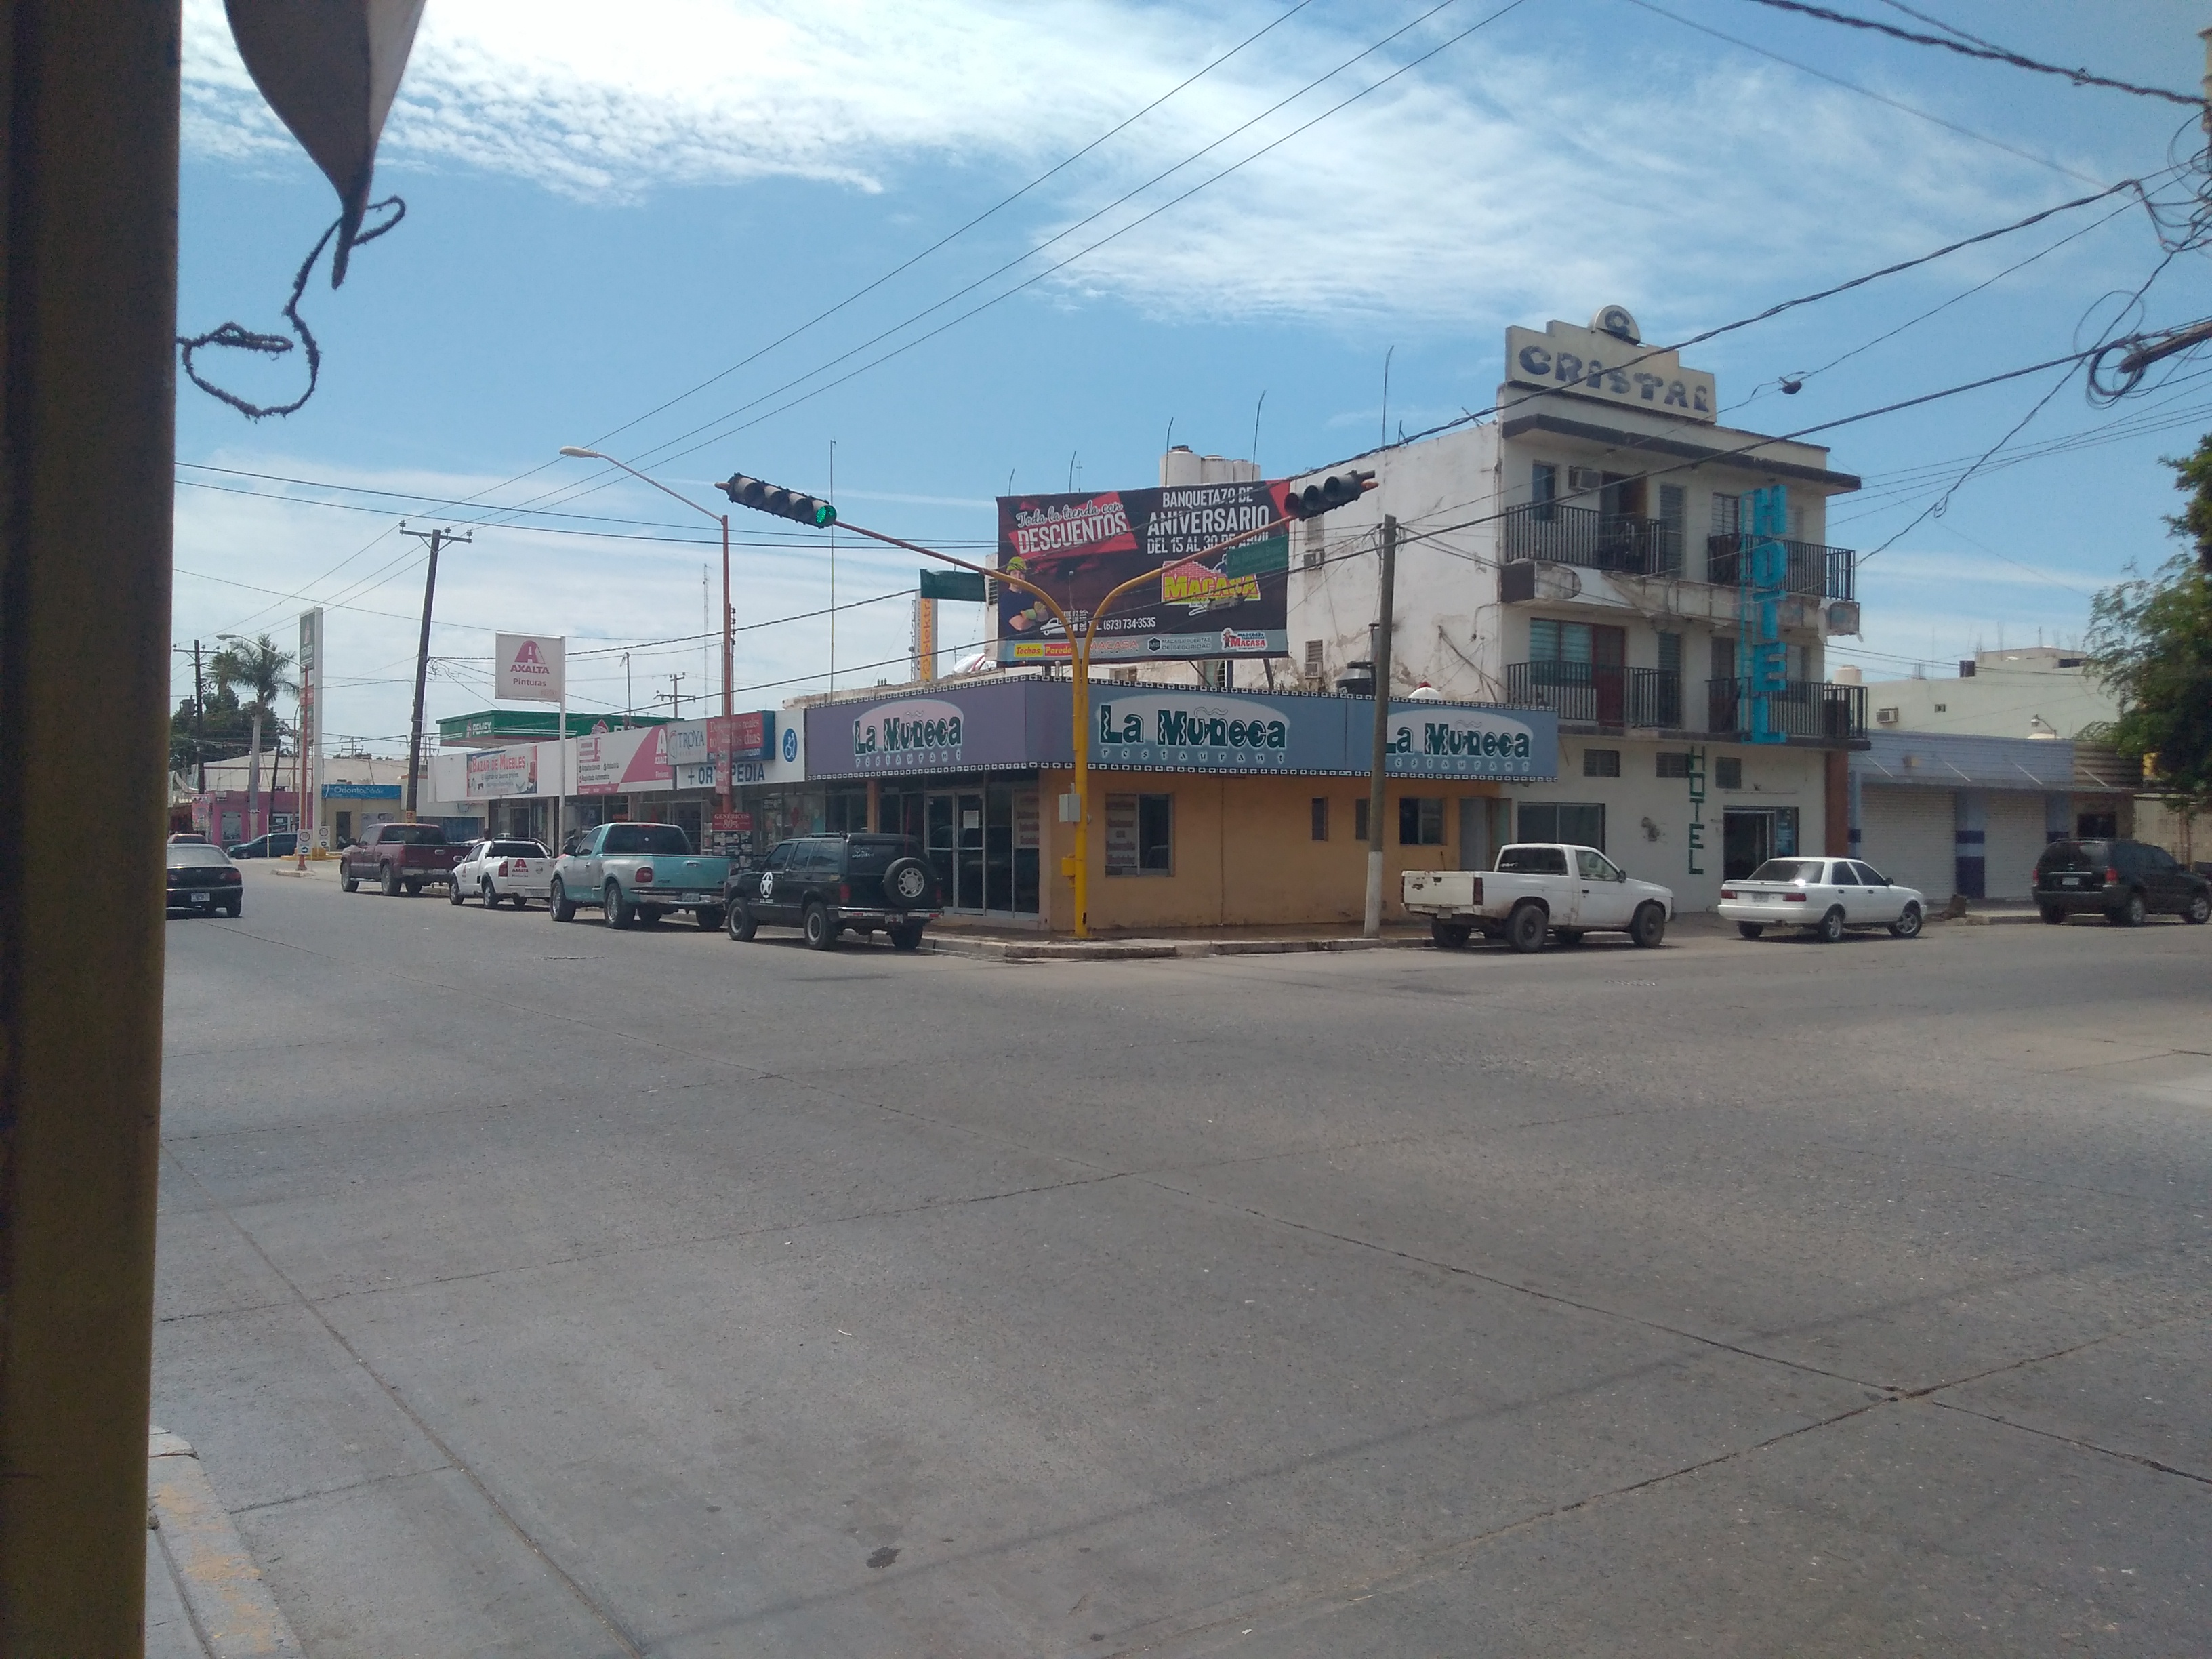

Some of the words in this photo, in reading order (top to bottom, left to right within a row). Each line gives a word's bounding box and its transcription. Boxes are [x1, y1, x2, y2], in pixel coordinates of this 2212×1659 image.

[1519, 345, 1709, 413] CRISTAL
[1162, 487, 1235, 509] BANQUETAZO
[1238, 486, 1253, 503] DE
[1017, 509, 1046, 528] Toda
[1048, 506, 1062, 523] la
[1063, 500, 1099, 520] tienda
[1102, 502, 1124, 514] con
[1147, 504, 1269, 537] ANIVERSARIO
[1017, 512, 1128, 554] DESCUENTOS
[1147, 537, 1168, 554] DEL
[1170, 537, 1183, 554] 15
[1186, 535, 1201, 552] AL
[1203, 534, 1218, 550] 30
[1164, 575, 1258, 598] MACASA
[1079, 609, 1089, 632] GRTIS
[1103, 618, 1122, 630] (673)
[1123, 617, 1156, 629] 734-3535
[1753, 484, 1787, 744] HOTEL
[1017, 646, 1041, 655] Techos
[1045, 644, 1073, 654] Parede
[1090, 639, 1138, 649] MACASA
[1229, 637, 1266, 647] MACASA
[510, 664, 550, 674] AXALTA
[513, 678, 546, 687] Pinturas
[855, 720, 878, 755] La
[883, 710, 962, 752] Muñeca
[1100, 704, 1145, 744] La
[1158, 707, 1286, 748] Muñeca
[678, 730, 705, 750] TROYA
[1425, 720, 1530, 758] Muñeca
[472, 756, 489, 773] BAZAR
[499, 754, 525, 770] MUEBLES
[655, 756, 668, 764] AXALT
[855, 748, 962, 768] restaurant
[1102, 748, 1285, 763] restaurant
[1395, 758, 1530, 771] estaurant
[699, 762, 765, 785] ORPEDIA
[1688, 745, 1706, 874] HOTEL
[722, 819, 739, 830] 80%
